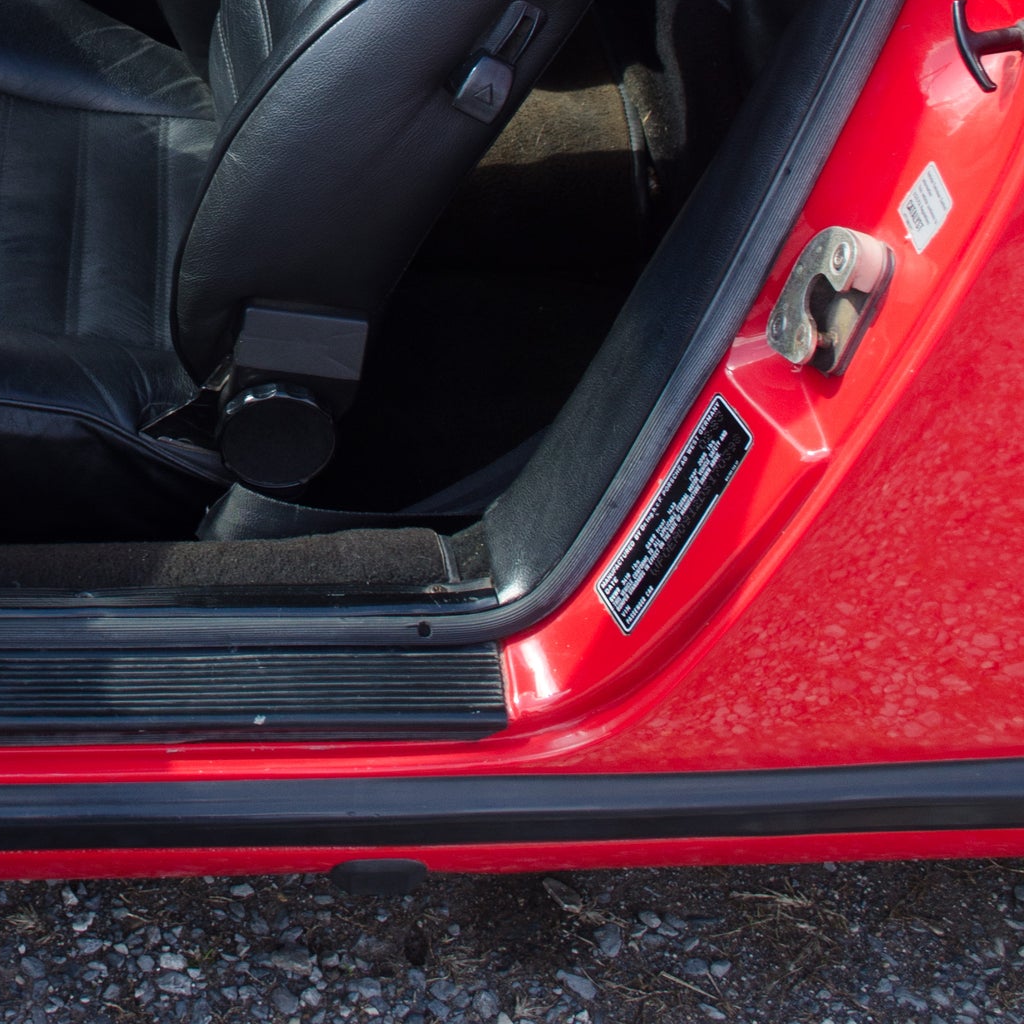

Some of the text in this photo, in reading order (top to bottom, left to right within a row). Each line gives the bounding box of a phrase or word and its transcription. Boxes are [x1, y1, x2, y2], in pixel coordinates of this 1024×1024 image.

[601, 541, 636, 590] MANUFACTURED
[634, 530, 642, 541] BY
[662, 465, 683, 496] PORSCHE
[687, 437, 700, 456] WEST
[699, 402, 721, 435] GERMANY
[605, 577, 619, 596] DATE
[621, 605, 631, 618] VIN
[626, 585, 653, 625] PASSENGER CAR
